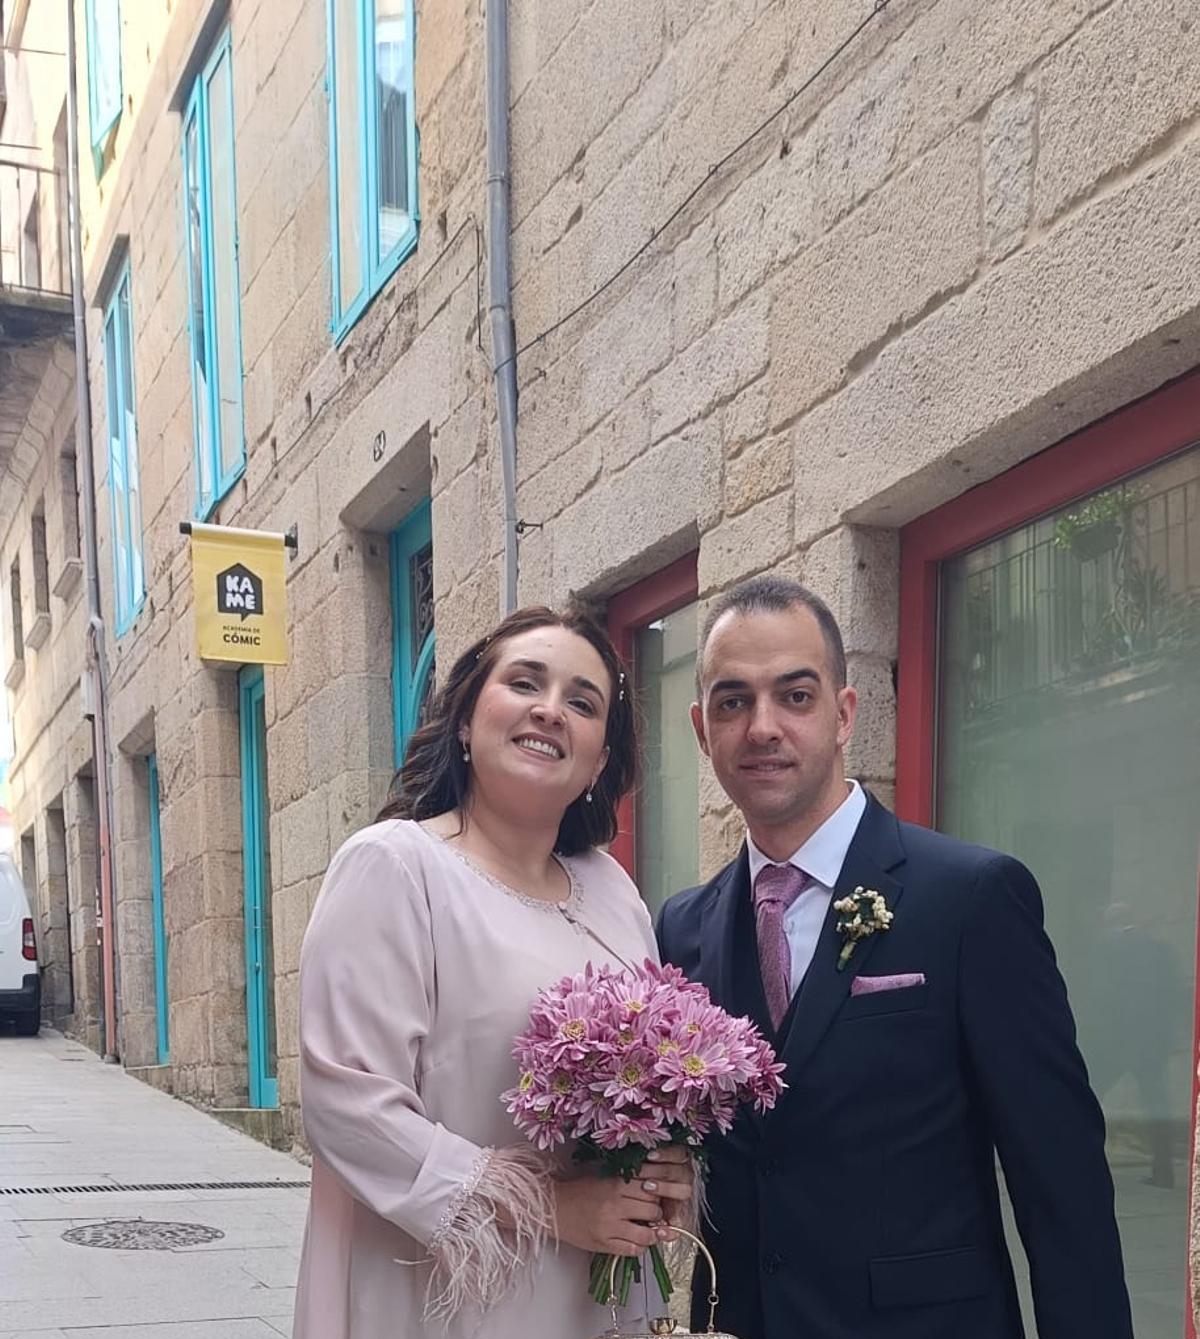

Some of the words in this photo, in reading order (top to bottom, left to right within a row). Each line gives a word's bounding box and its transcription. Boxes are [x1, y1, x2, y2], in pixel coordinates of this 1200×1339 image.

[225, 575, 254, 593] KA
[225, 593, 255, 610] ME
[223, 632, 261, 645] CÓMIC
